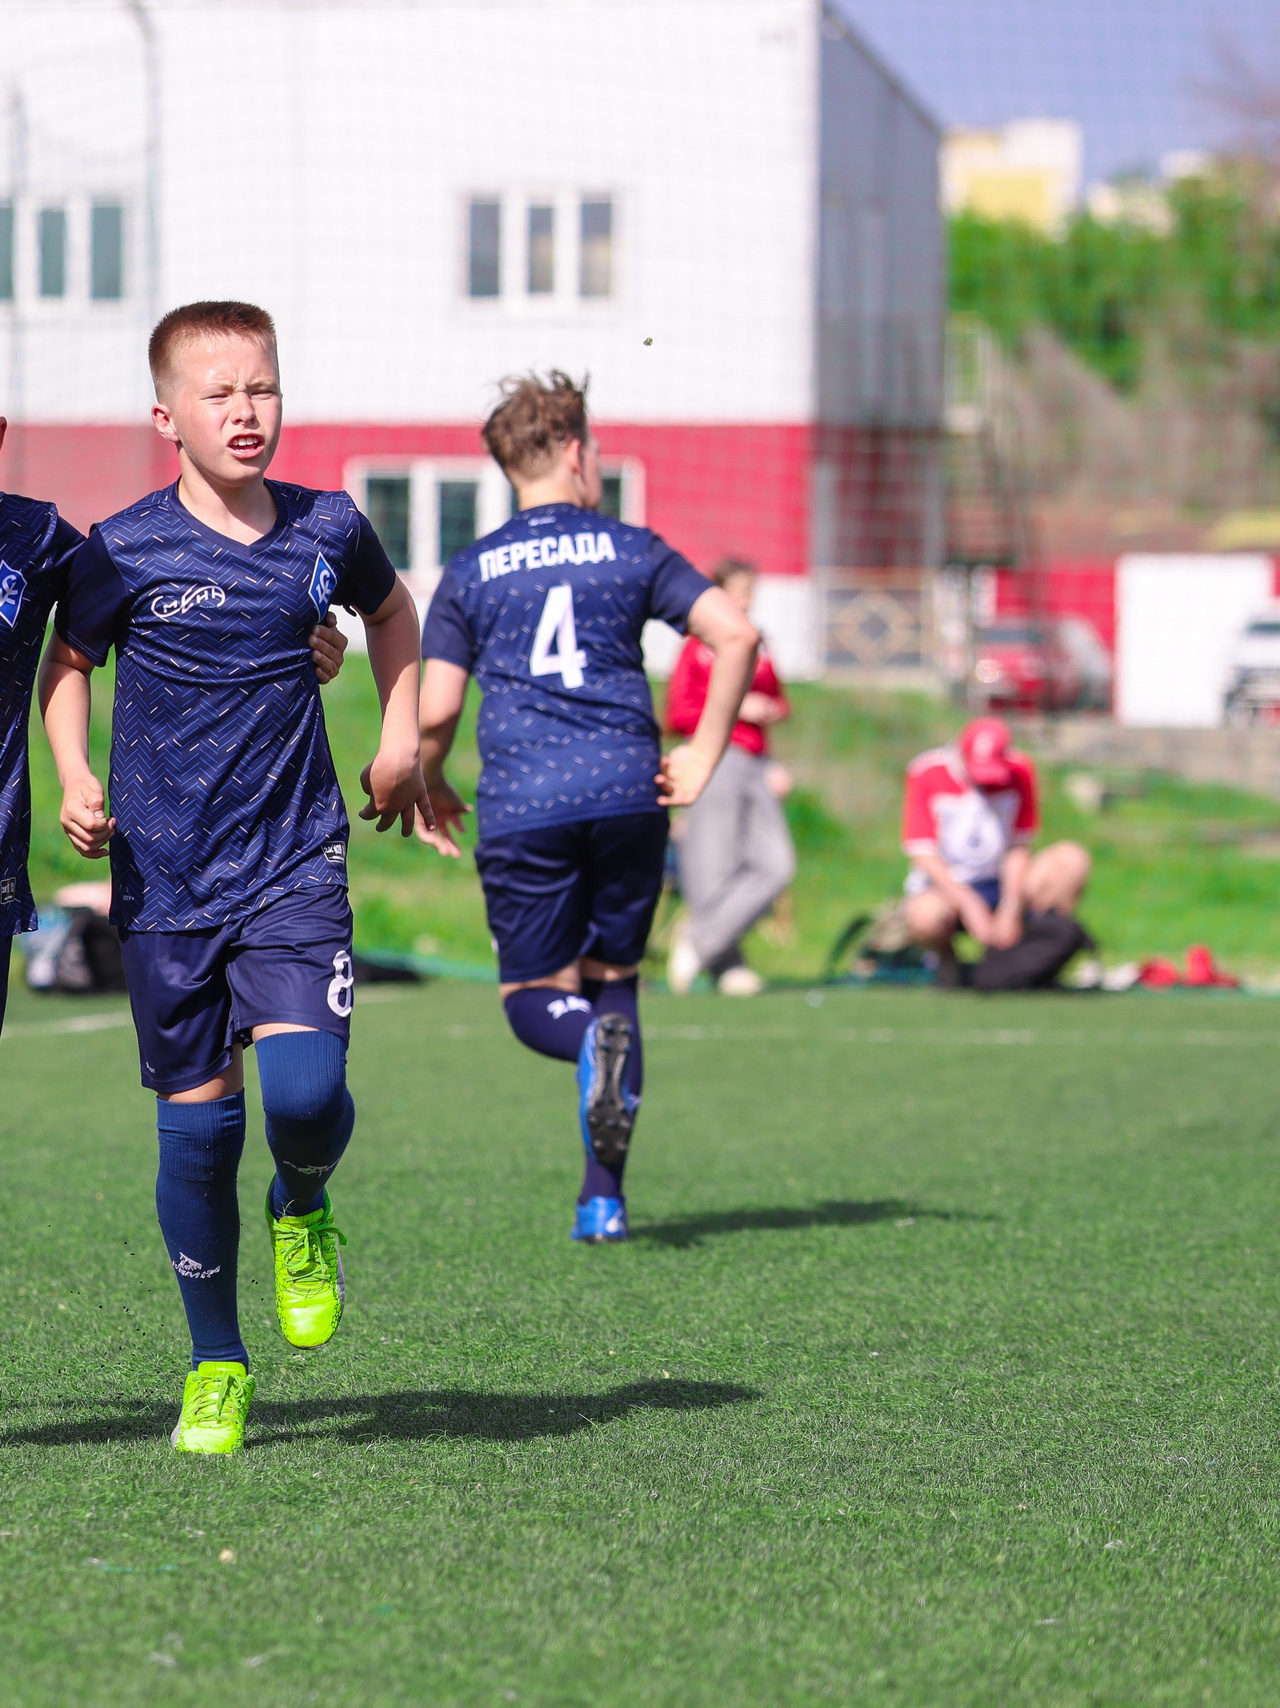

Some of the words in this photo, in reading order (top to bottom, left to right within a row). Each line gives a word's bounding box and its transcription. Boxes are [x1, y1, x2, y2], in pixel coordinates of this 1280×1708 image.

[478, 532, 616, 582] ПЕРЕСАДА
[529, 585, 588, 689] 4
[327, 950, 354, 1017] 8
